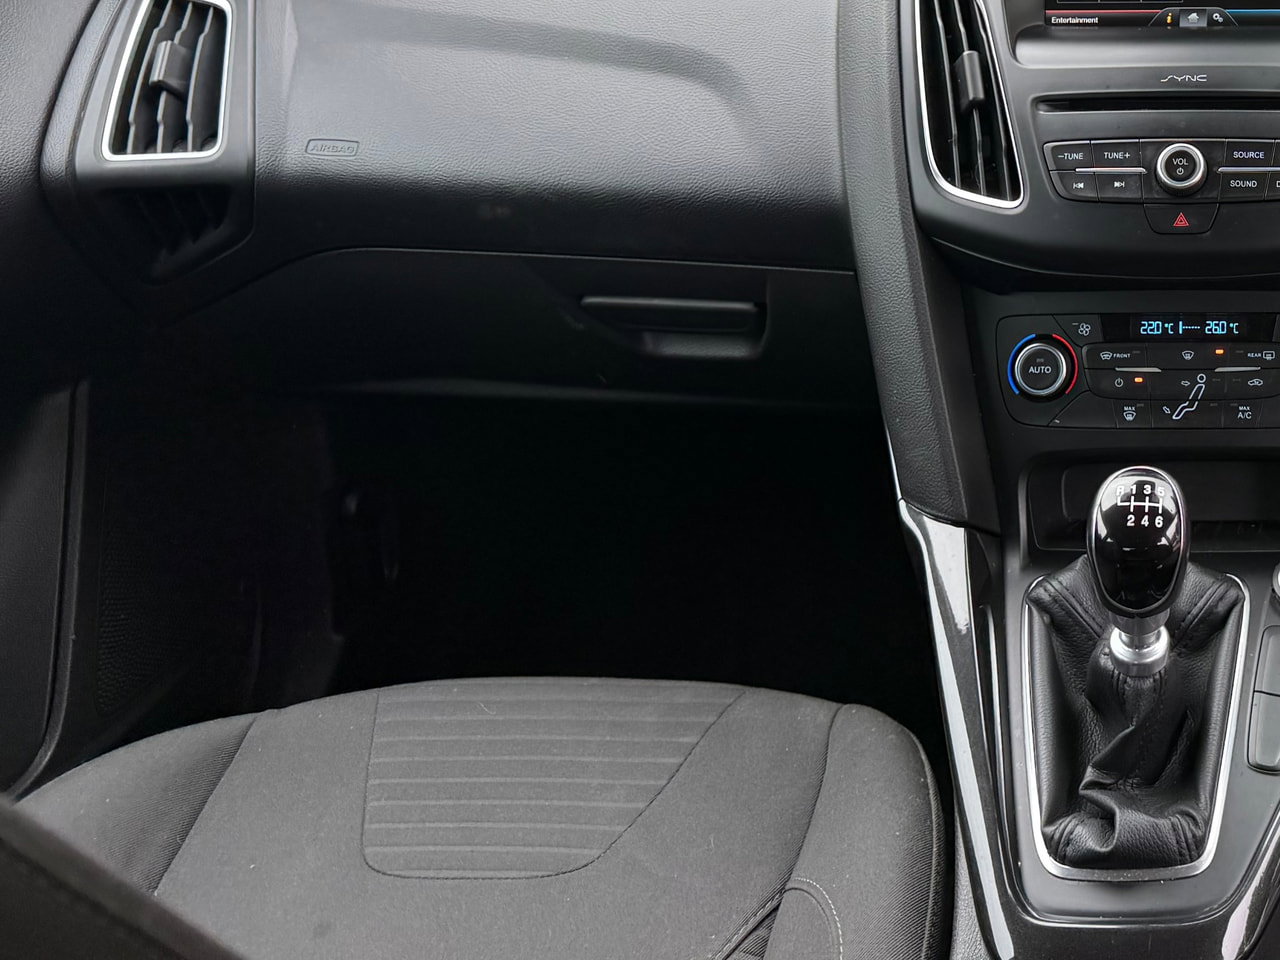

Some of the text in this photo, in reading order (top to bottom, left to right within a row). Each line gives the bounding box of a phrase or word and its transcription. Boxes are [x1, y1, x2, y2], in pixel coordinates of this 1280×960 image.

[1051, 16, 1099, 24] Entertainment
[1160, 74, 1207, 82] SYNC
[310, 143, 355, 154] AIRBAG
[1233, 150, 1265, 159] SOURCE
[1172, 157, 1189, 166] VOL
[1230, 179, 1258, 188] SOUND
[1028, 365, 1051, 375] AUTO
[1237, 411, 1252, 419] A/C
[1130, 484, 1137, 495] 1
[1143, 484, 1152, 495] 3
[1157, 486, 1165, 497] 5
[1126, 514, 1164, 528] 2 4 6
